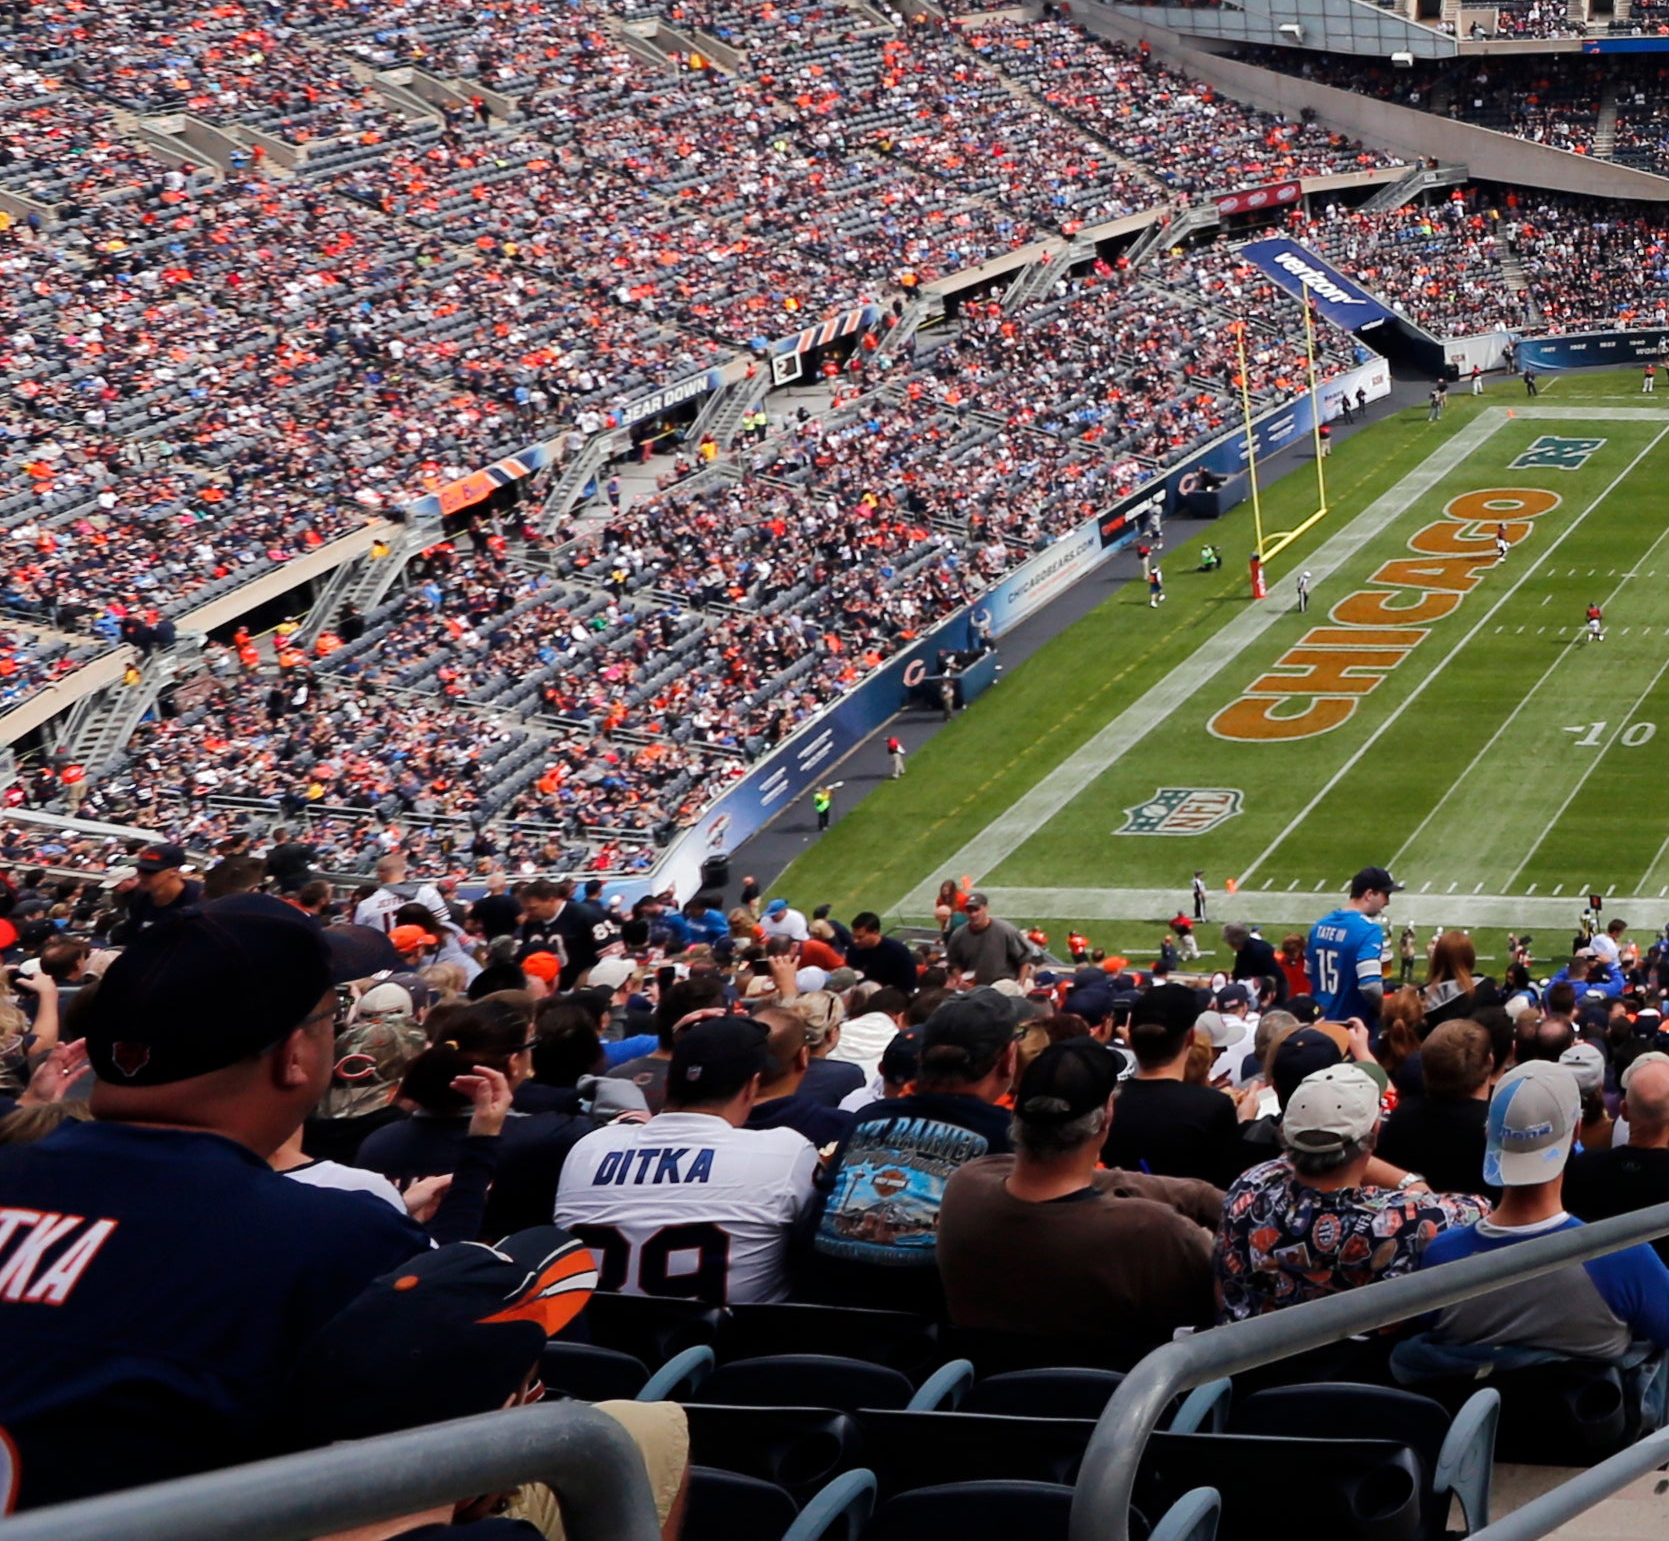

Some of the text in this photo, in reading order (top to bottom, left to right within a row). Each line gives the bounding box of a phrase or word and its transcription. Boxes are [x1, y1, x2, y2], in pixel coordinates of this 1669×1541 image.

[1274, 252, 1352, 304] verizon
[1635, 346, 1669, 356] WORD
[664, 377, 709, 408] DOWN
[1008, 537, 1096, 605] CHICAGOBEARS.COM
[1206, 487, 1564, 742] CHICAGO
[1573, 721, 1658, 748] 10
[1316, 925, 1335, 942] TATE
[1316, 949, 1339, 995] 15
[592, 1148, 716, 1186] DITKA
[0, 1206, 119, 1307] TKA
